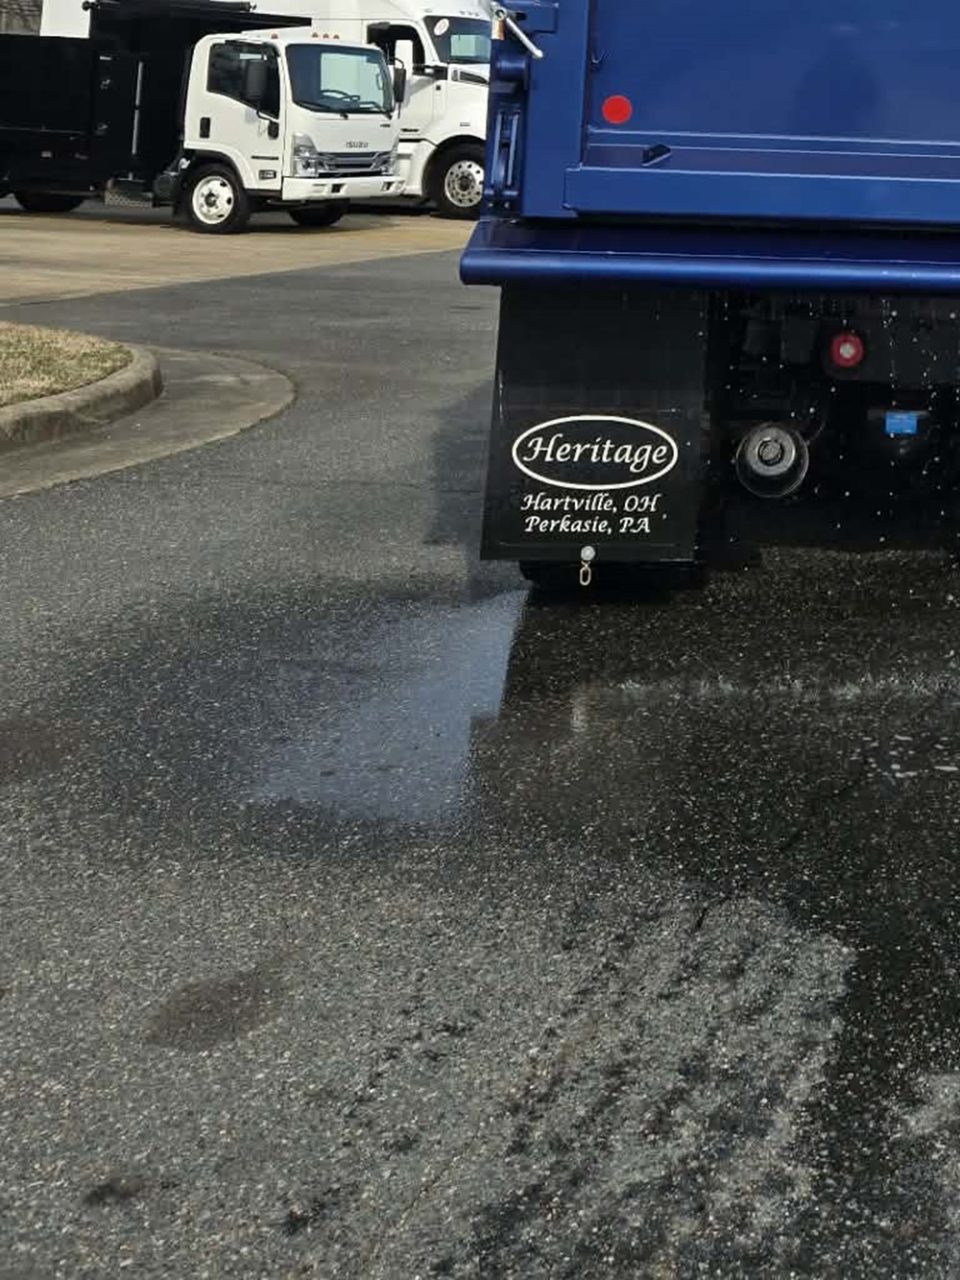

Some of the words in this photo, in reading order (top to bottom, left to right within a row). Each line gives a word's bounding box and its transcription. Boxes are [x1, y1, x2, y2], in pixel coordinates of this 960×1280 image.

[523, 433, 668, 473] Heritage
[520, 492, 617, 513] Hartville,
[623, 493, 662, 512] OH
[524, 515, 612, 535] Perkasie,
[619, 517, 650, 533] PA
